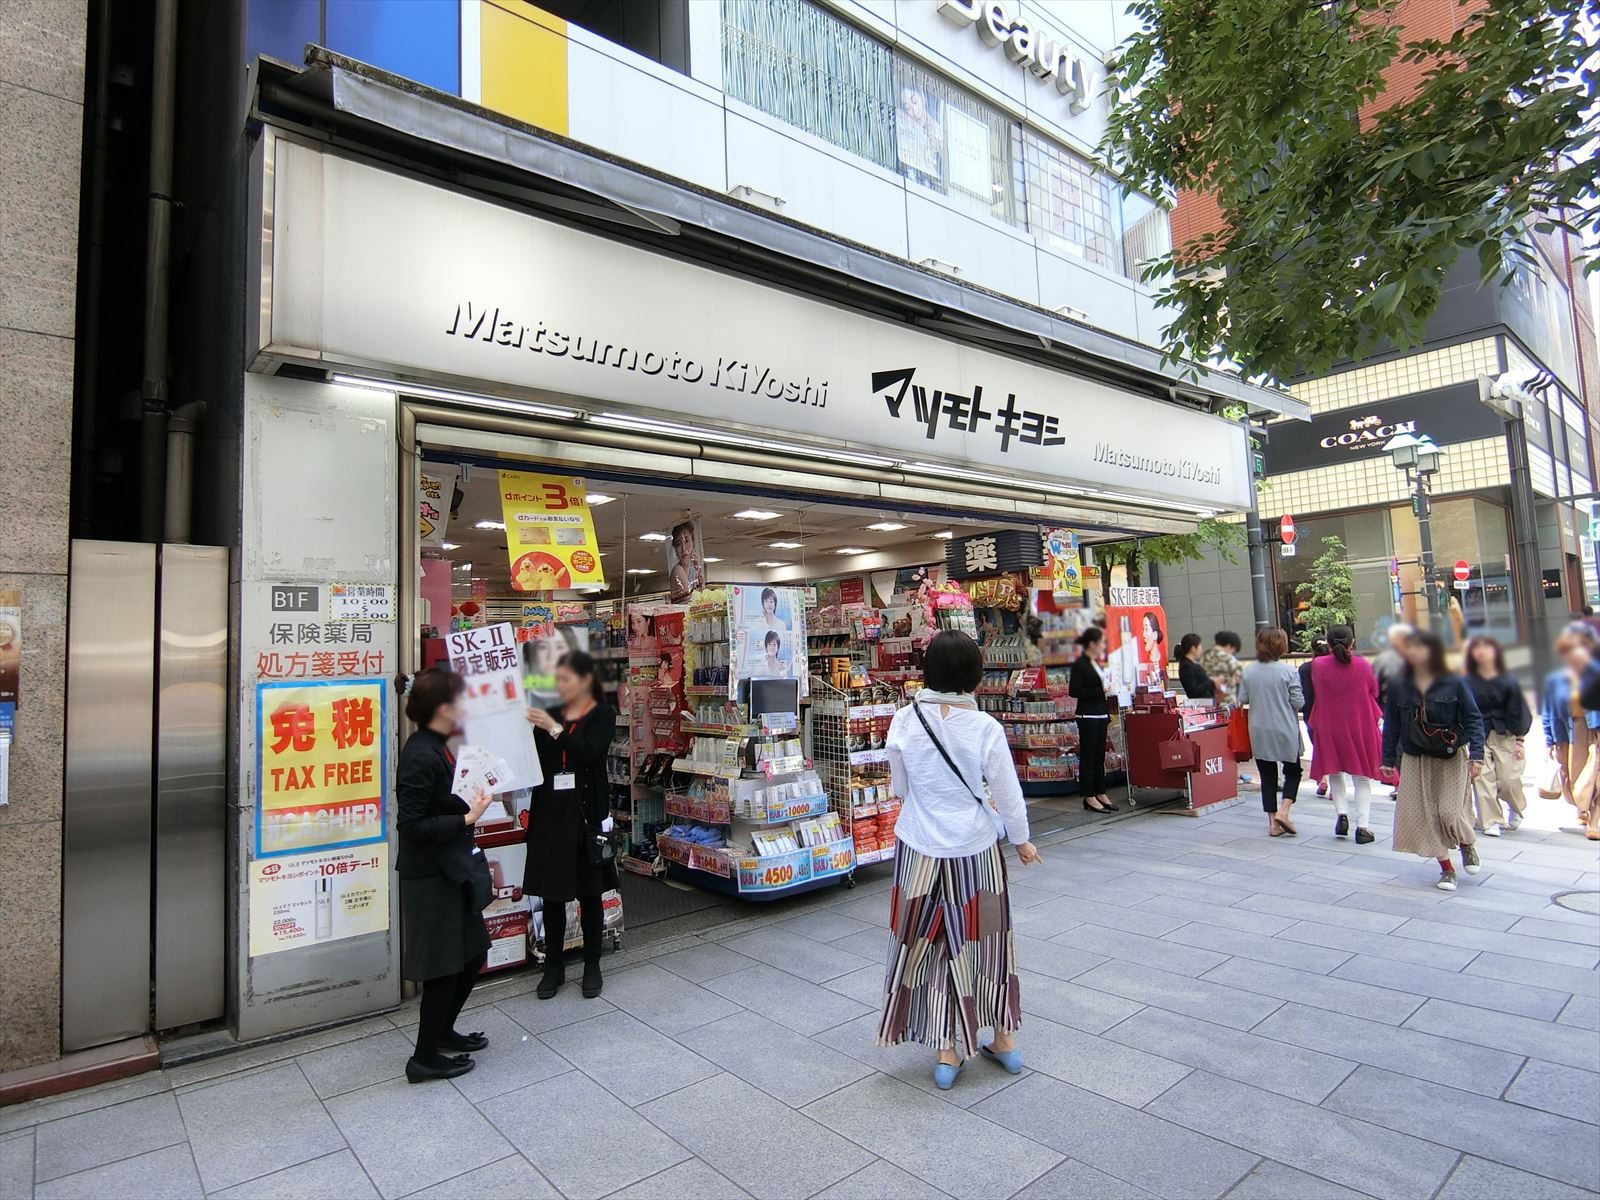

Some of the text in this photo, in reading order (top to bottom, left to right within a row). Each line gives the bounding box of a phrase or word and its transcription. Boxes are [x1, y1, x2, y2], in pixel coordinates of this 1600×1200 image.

[446, 300, 702, 384] Matsumoto
[872, 367, 1066, 453] マツモトキヨシ
[1320, 420, 1417, 448] COACH
[1349, 439, 1386, 451] NEW YORK
[1093, 441, 1175, 478] Matsumoto
[964, 536, 998, 572] 薬
[346, 587, 385, 597] 営業時間
[269, 622, 372, 645] 保険薬局
[257, 650, 385, 679] 処方箋受付
[452, 646, 518, 677] 限定販売
[270, 697, 375, 755] 免税
[270, 759, 373, 792] TAX FREE
[788, 802, 810, 816] 10000
[765, 864, 793, 885] 4500
